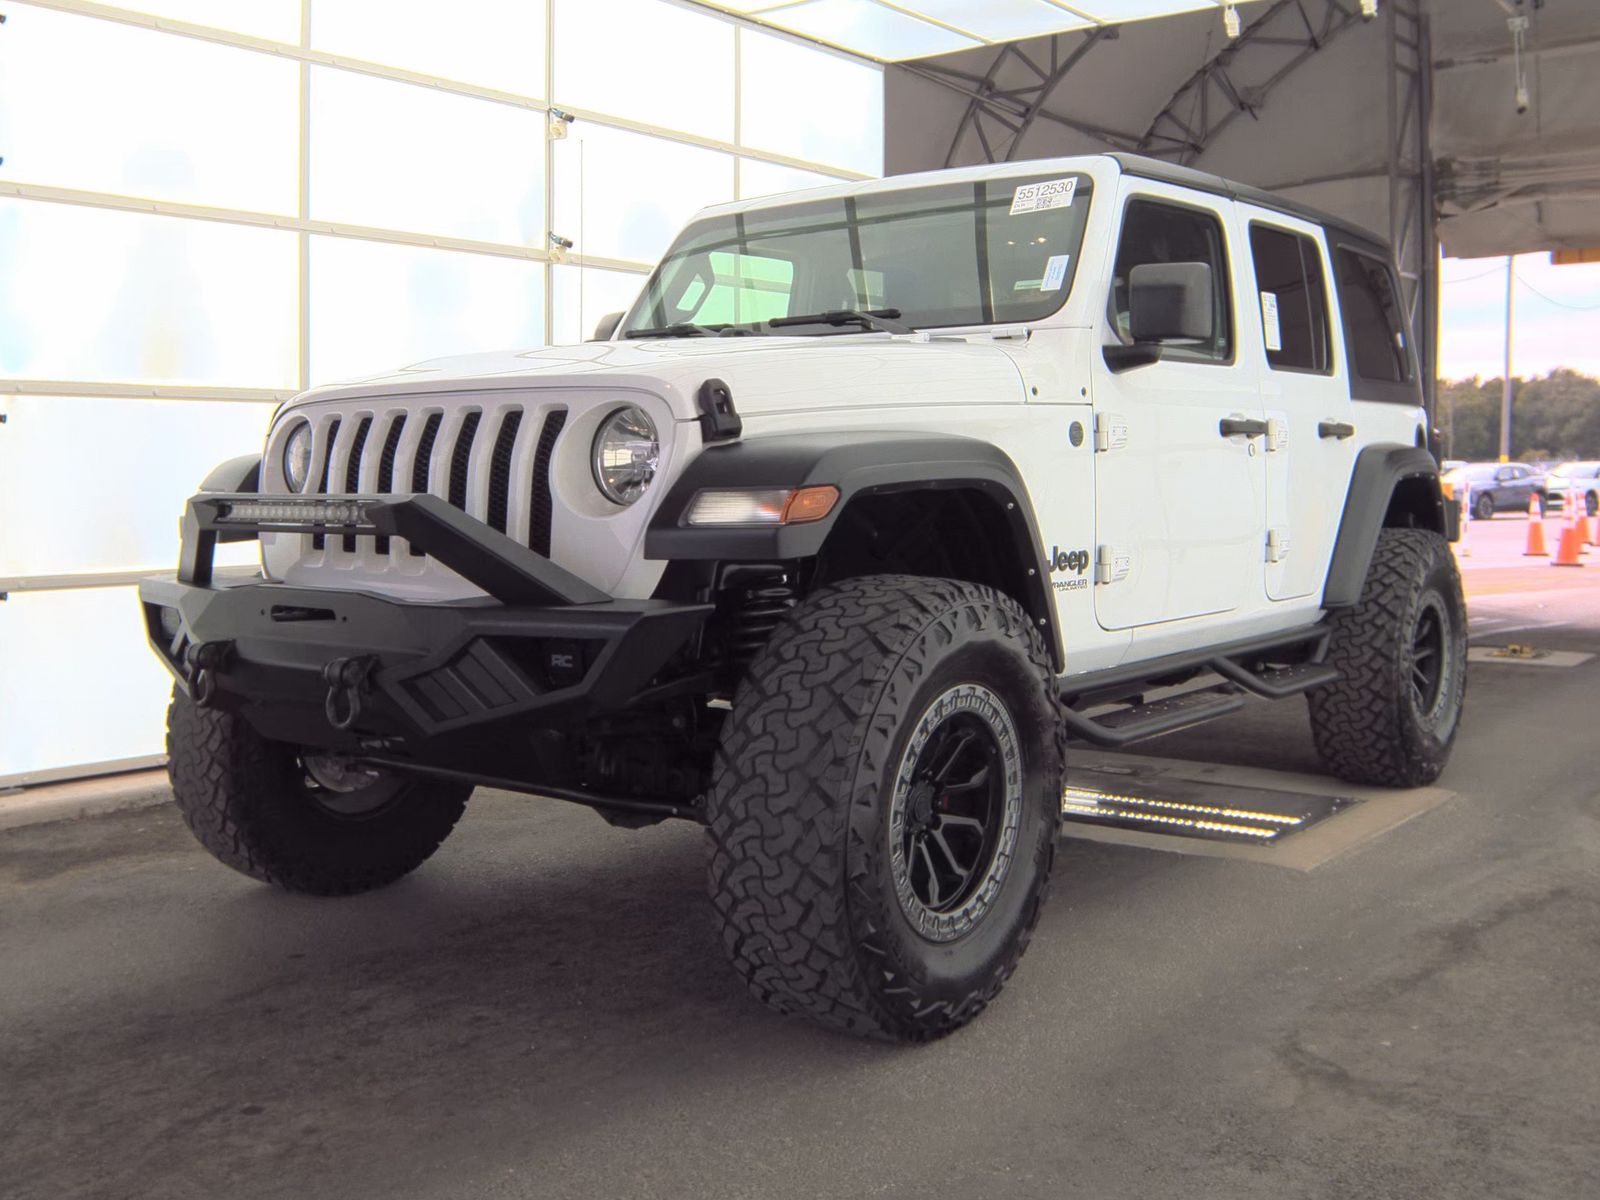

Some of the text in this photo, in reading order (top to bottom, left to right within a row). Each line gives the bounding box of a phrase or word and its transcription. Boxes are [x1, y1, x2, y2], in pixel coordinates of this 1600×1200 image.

[1018, 180, 1073, 200] 5512530
[1049, 545, 1089, 575] Jeep
[1052, 579, 1087, 589] RANGLER
[551, 654, 573, 668] RC
